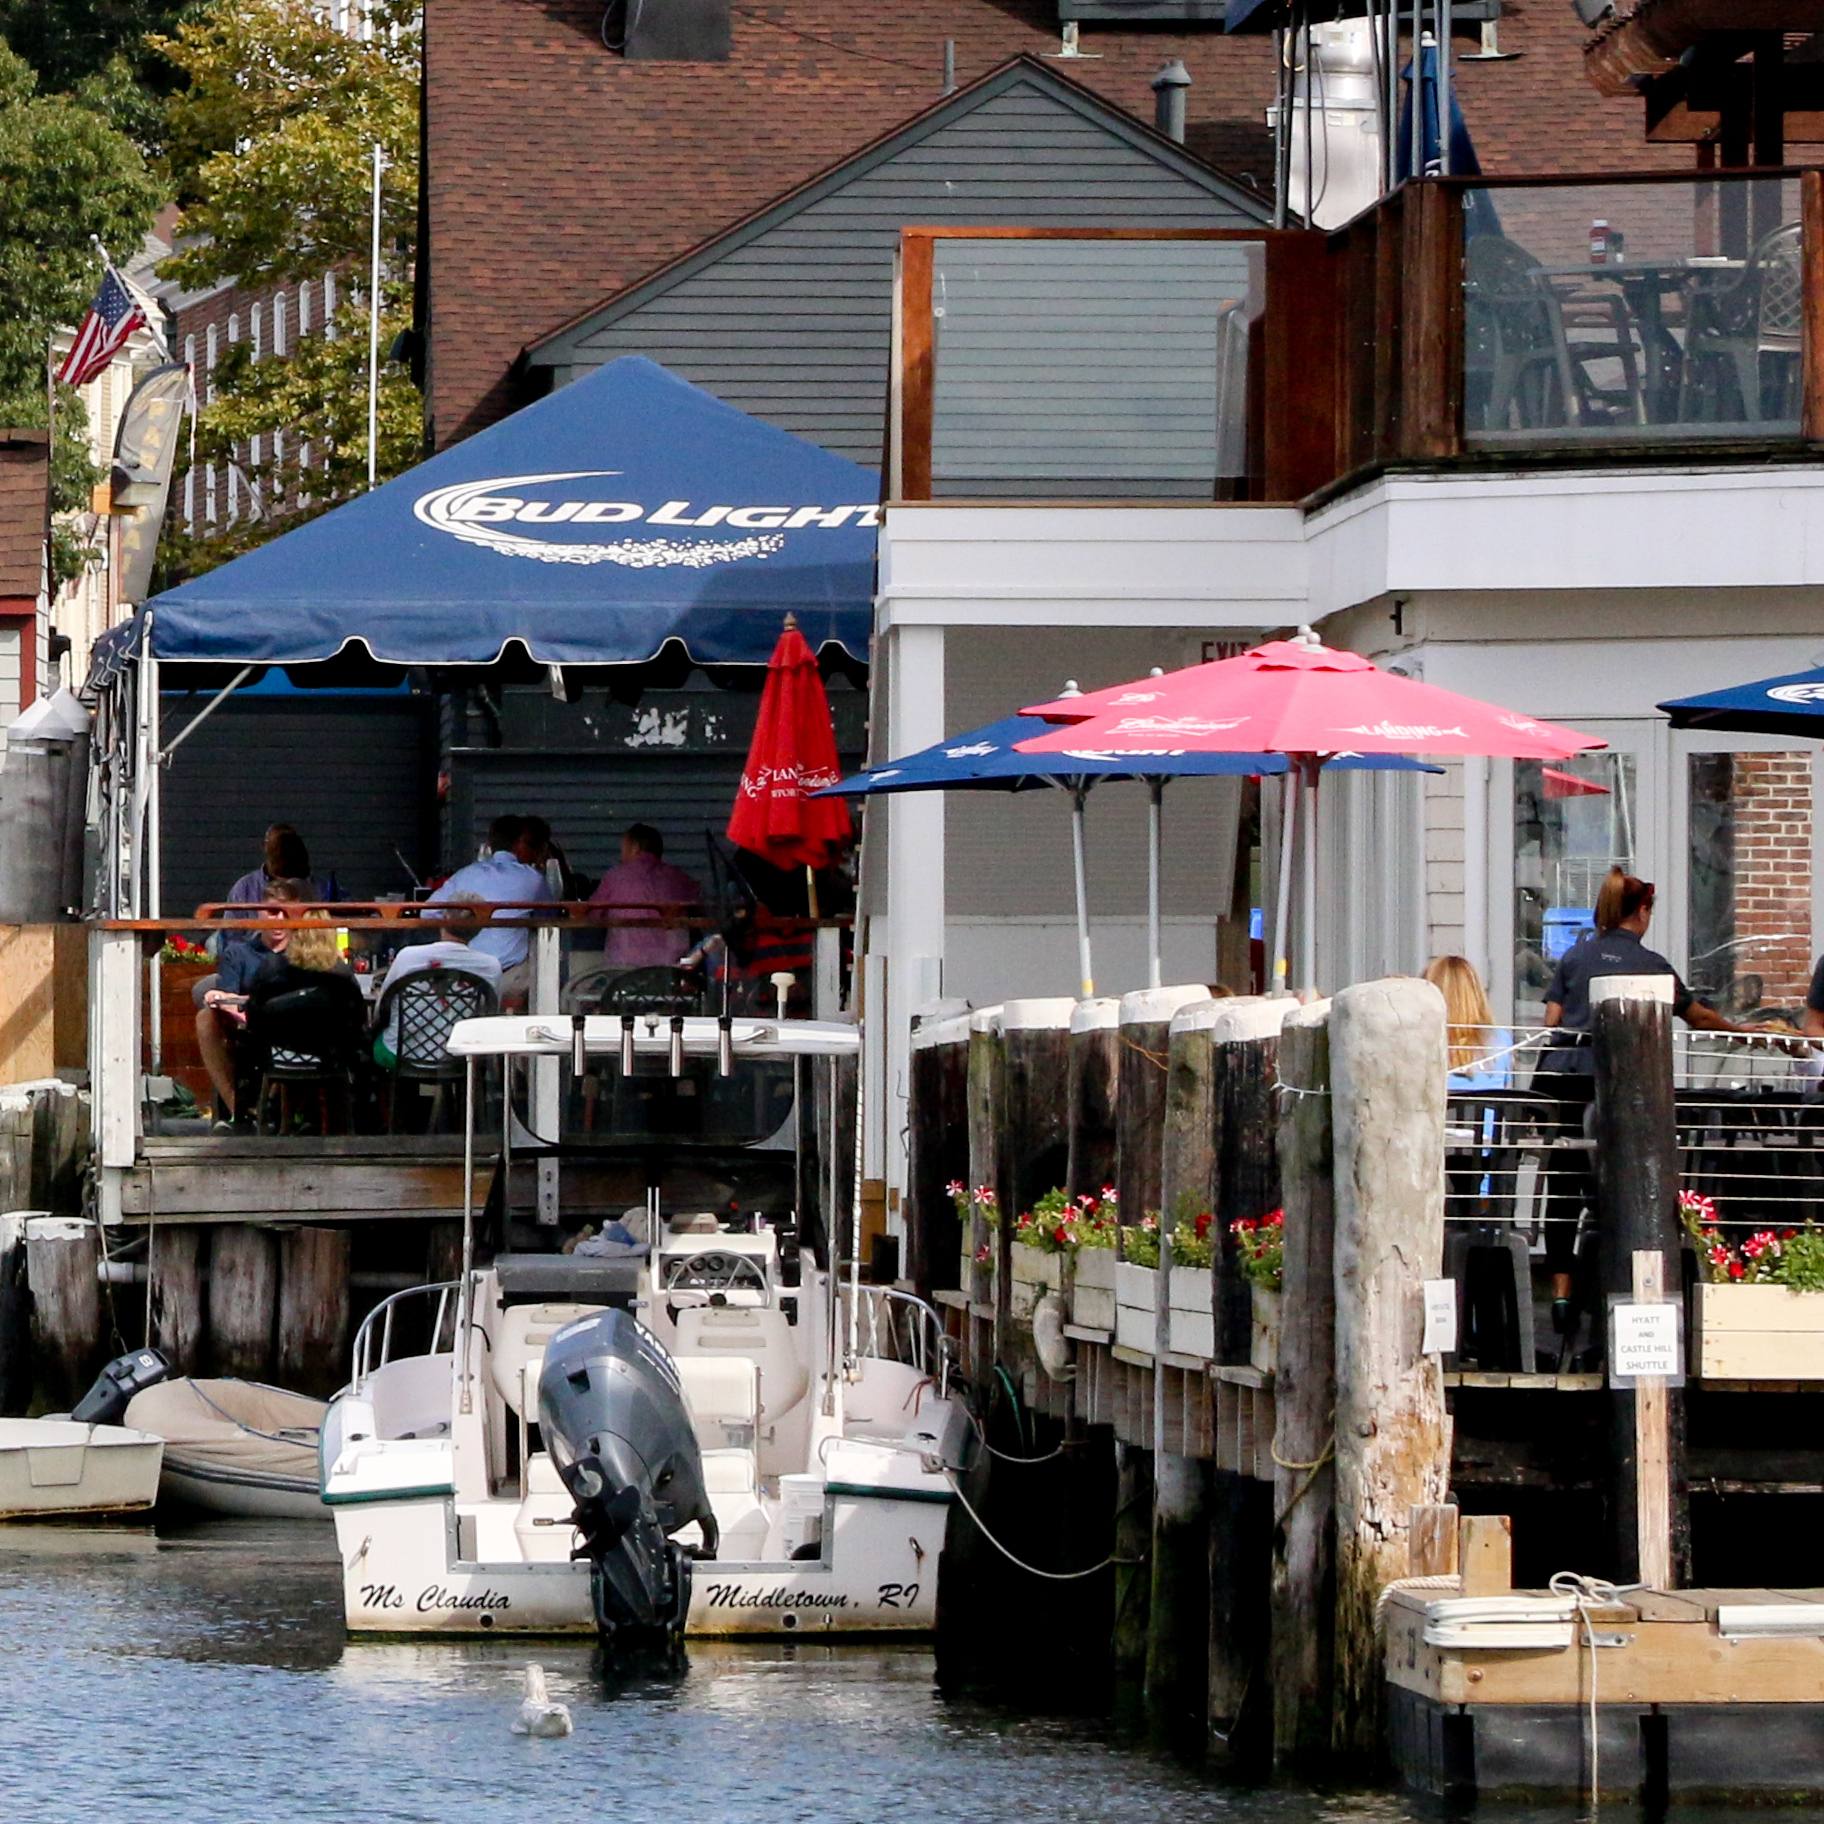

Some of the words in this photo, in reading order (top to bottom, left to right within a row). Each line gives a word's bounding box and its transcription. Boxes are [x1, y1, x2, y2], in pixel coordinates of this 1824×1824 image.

[447, 496, 645, 523] BUD
[645, 501, 881, 529] LIGHT
[1362, 723, 1443, 738] LANDING
[1631, 1316, 1661, 1324] HYATT
[1620, 1344, 1652, 1354] CASTLE
[1654, 1344, 1673, 1353] HILL
[1625, 1360, 1669, 1370] SHUTTLE
[359, 1583, 406, 1609] Ms
[415, 1583, 512, 1613] Claudia
[877, 1583, 921, 1609] RI
